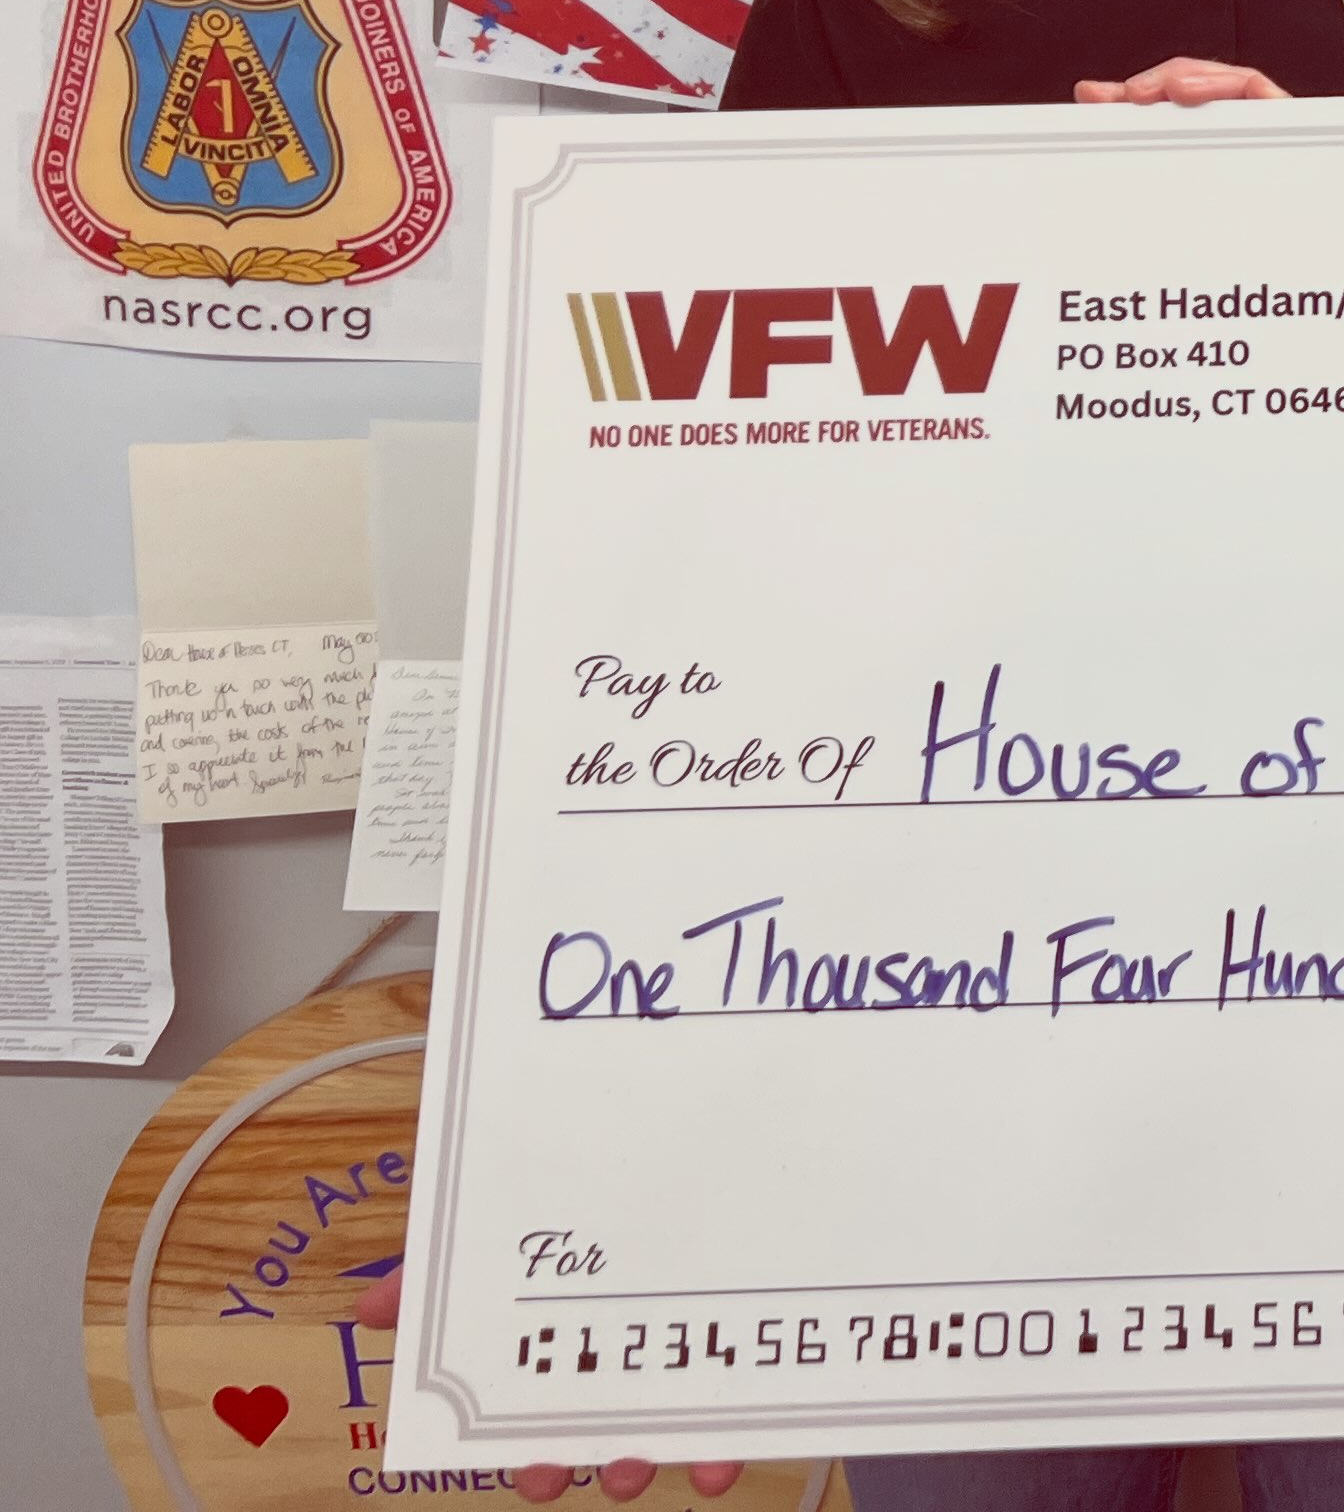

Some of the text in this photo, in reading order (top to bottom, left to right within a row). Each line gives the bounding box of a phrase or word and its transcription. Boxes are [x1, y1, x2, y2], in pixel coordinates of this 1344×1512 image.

[160, 54, 290, 154] LABOR OMNIA
[393, 107, 417, 135] OF
[183, 139, 271, 161] VINCIT
[42, 149, 96, 243] UNITED
[378, 148, 437, 257] AMERICA
[104, 296, 370, 340] nasrcc.org
[1060, 291, 1146, 321] East
[625, 282, 1021, 401] VFW
[1058, 340, 1249, 370] PO Box 410
[590, 418, 993, 448] NO ONE DOES MORE FOR VETERANS.
[1057, 391, 1200, 422] Moodus,
[1212, 389, 1255, 415] CT
[575, 655, 721, 719] Pay to
[920, 662, 1207, 804] House
[1240, 716, 1327, 797] of
[564, 736, 877, 802] the Order Of
[540, 929, 682, 1020] One
[681, 896, 1013, 1013] Thousand
[1046, 915, 1193, 1017] Four
[219, 1151, 410, 1320] You Are
[520, 1231, 606, 1278] For
